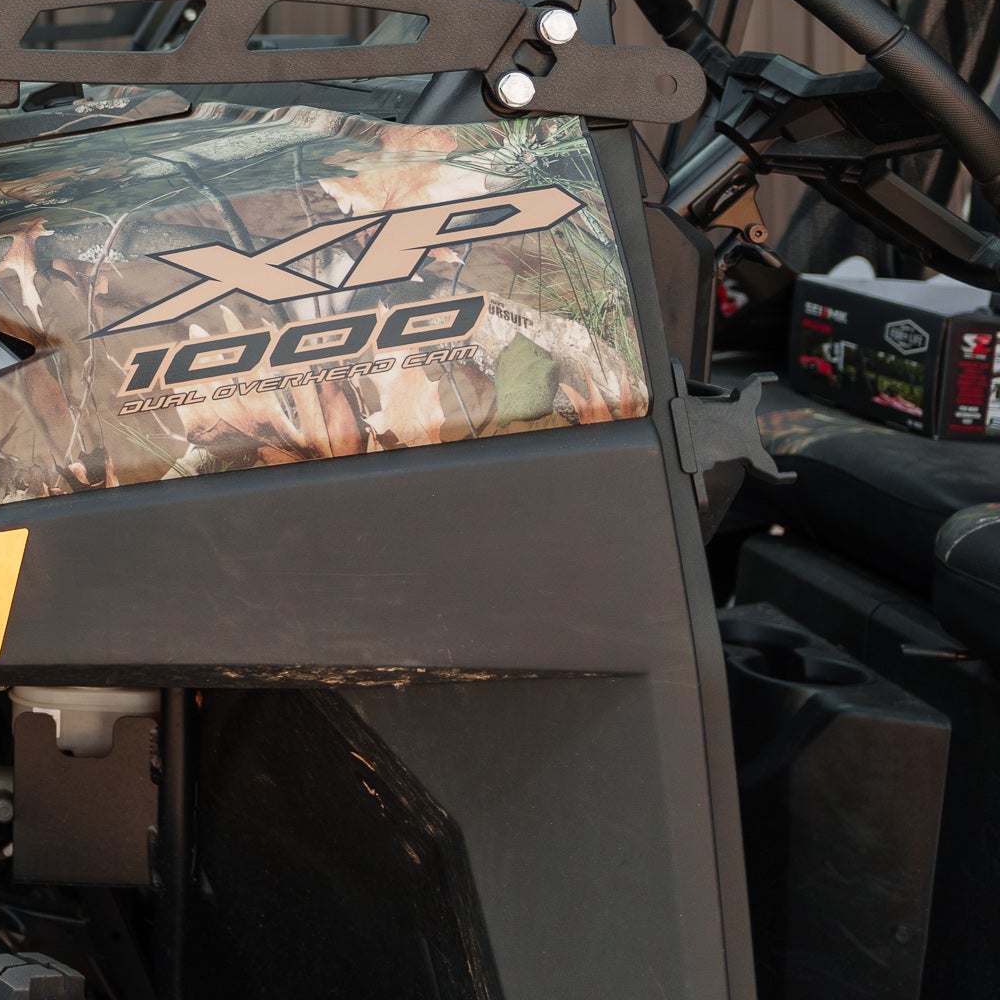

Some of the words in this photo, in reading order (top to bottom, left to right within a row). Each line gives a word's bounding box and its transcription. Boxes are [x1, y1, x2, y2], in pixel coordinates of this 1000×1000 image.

[81, 185, 588, 340] XP
[117, 291, 488, 398] 1000
[488, 303, 530, 329] URSUIT
[118, 390, 206, 416] DUAL
[211, 358, 396, 401] OVERHEAD
[402, 344, 479, 369] CAM
